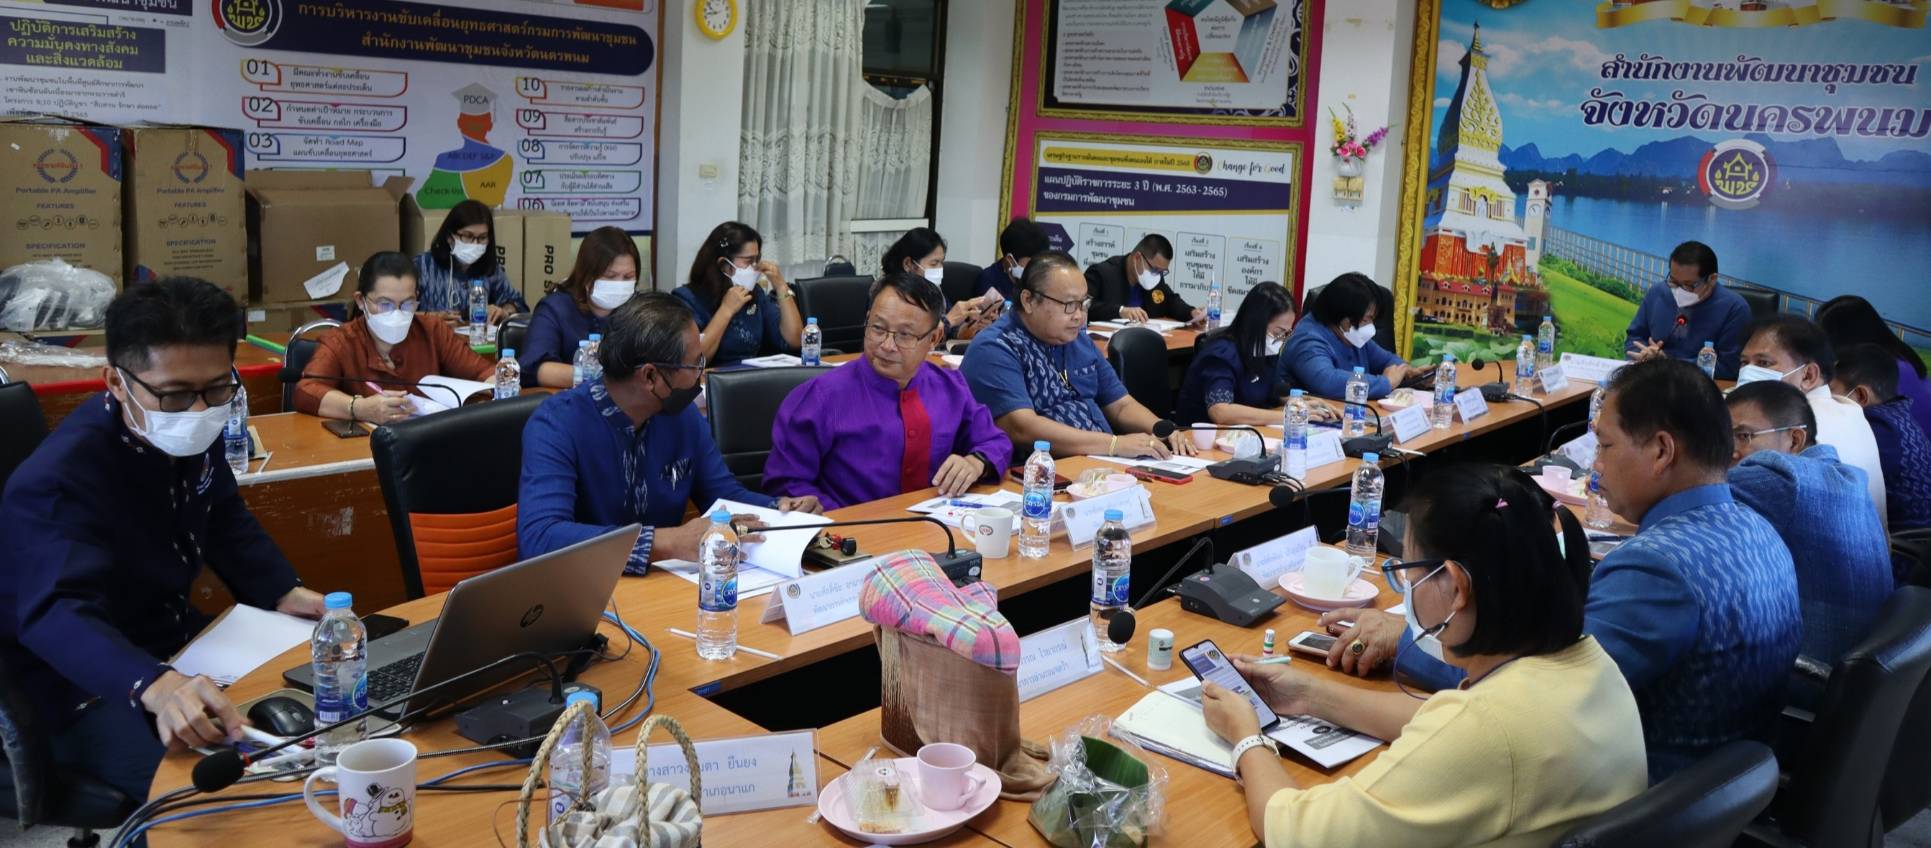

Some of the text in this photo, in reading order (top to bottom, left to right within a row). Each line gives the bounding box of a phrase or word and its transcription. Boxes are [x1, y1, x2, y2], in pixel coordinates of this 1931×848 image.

[10, 18, 137, 40] ปฏิบัติการเสริมสร้าง
[8, 34, 139, 56] ความมั่นคงทางสังคม
[361, 32, 590, 64] สำนักงานพัฒนาชุมชนจังหวัดนครพนม
[26, 53, 123, 69] และสิ่งแวดล้อม
[247, 59, 270, 76] 01
[1601, 54, 1920, 95] สำนักงานพัฒนาชุมชน
[522, 77, 541, 92] 10
[248, 97, 274, 113] 02
[463, 95, 489, 105] PDCA
[522, 109, 541, 123] 09
[1579, 88, 1931, 139] จังหวัดนครพนม
[248, 132, 273, 149] 03
[521, 139, 541, 153] 08
[1249, 161, 1262, 176] for
[523, 170, 542, 184] 07
[1044, 175, 1132, 191] แผนปฏิบัติราชการระยะ
[1134, 181, 1140, 191] 3
[1142, 180, 1150, 191] ปี
[522, 198, 541, 210] 06
[1043, 191, 1136, 209] ของกรมการพัฒนาชุมชน
[26, 242, 86, 250] SPECIFICATION
[544, 245, 554, 275] PRO
[728, 755, 757, 770] ยืนยง
